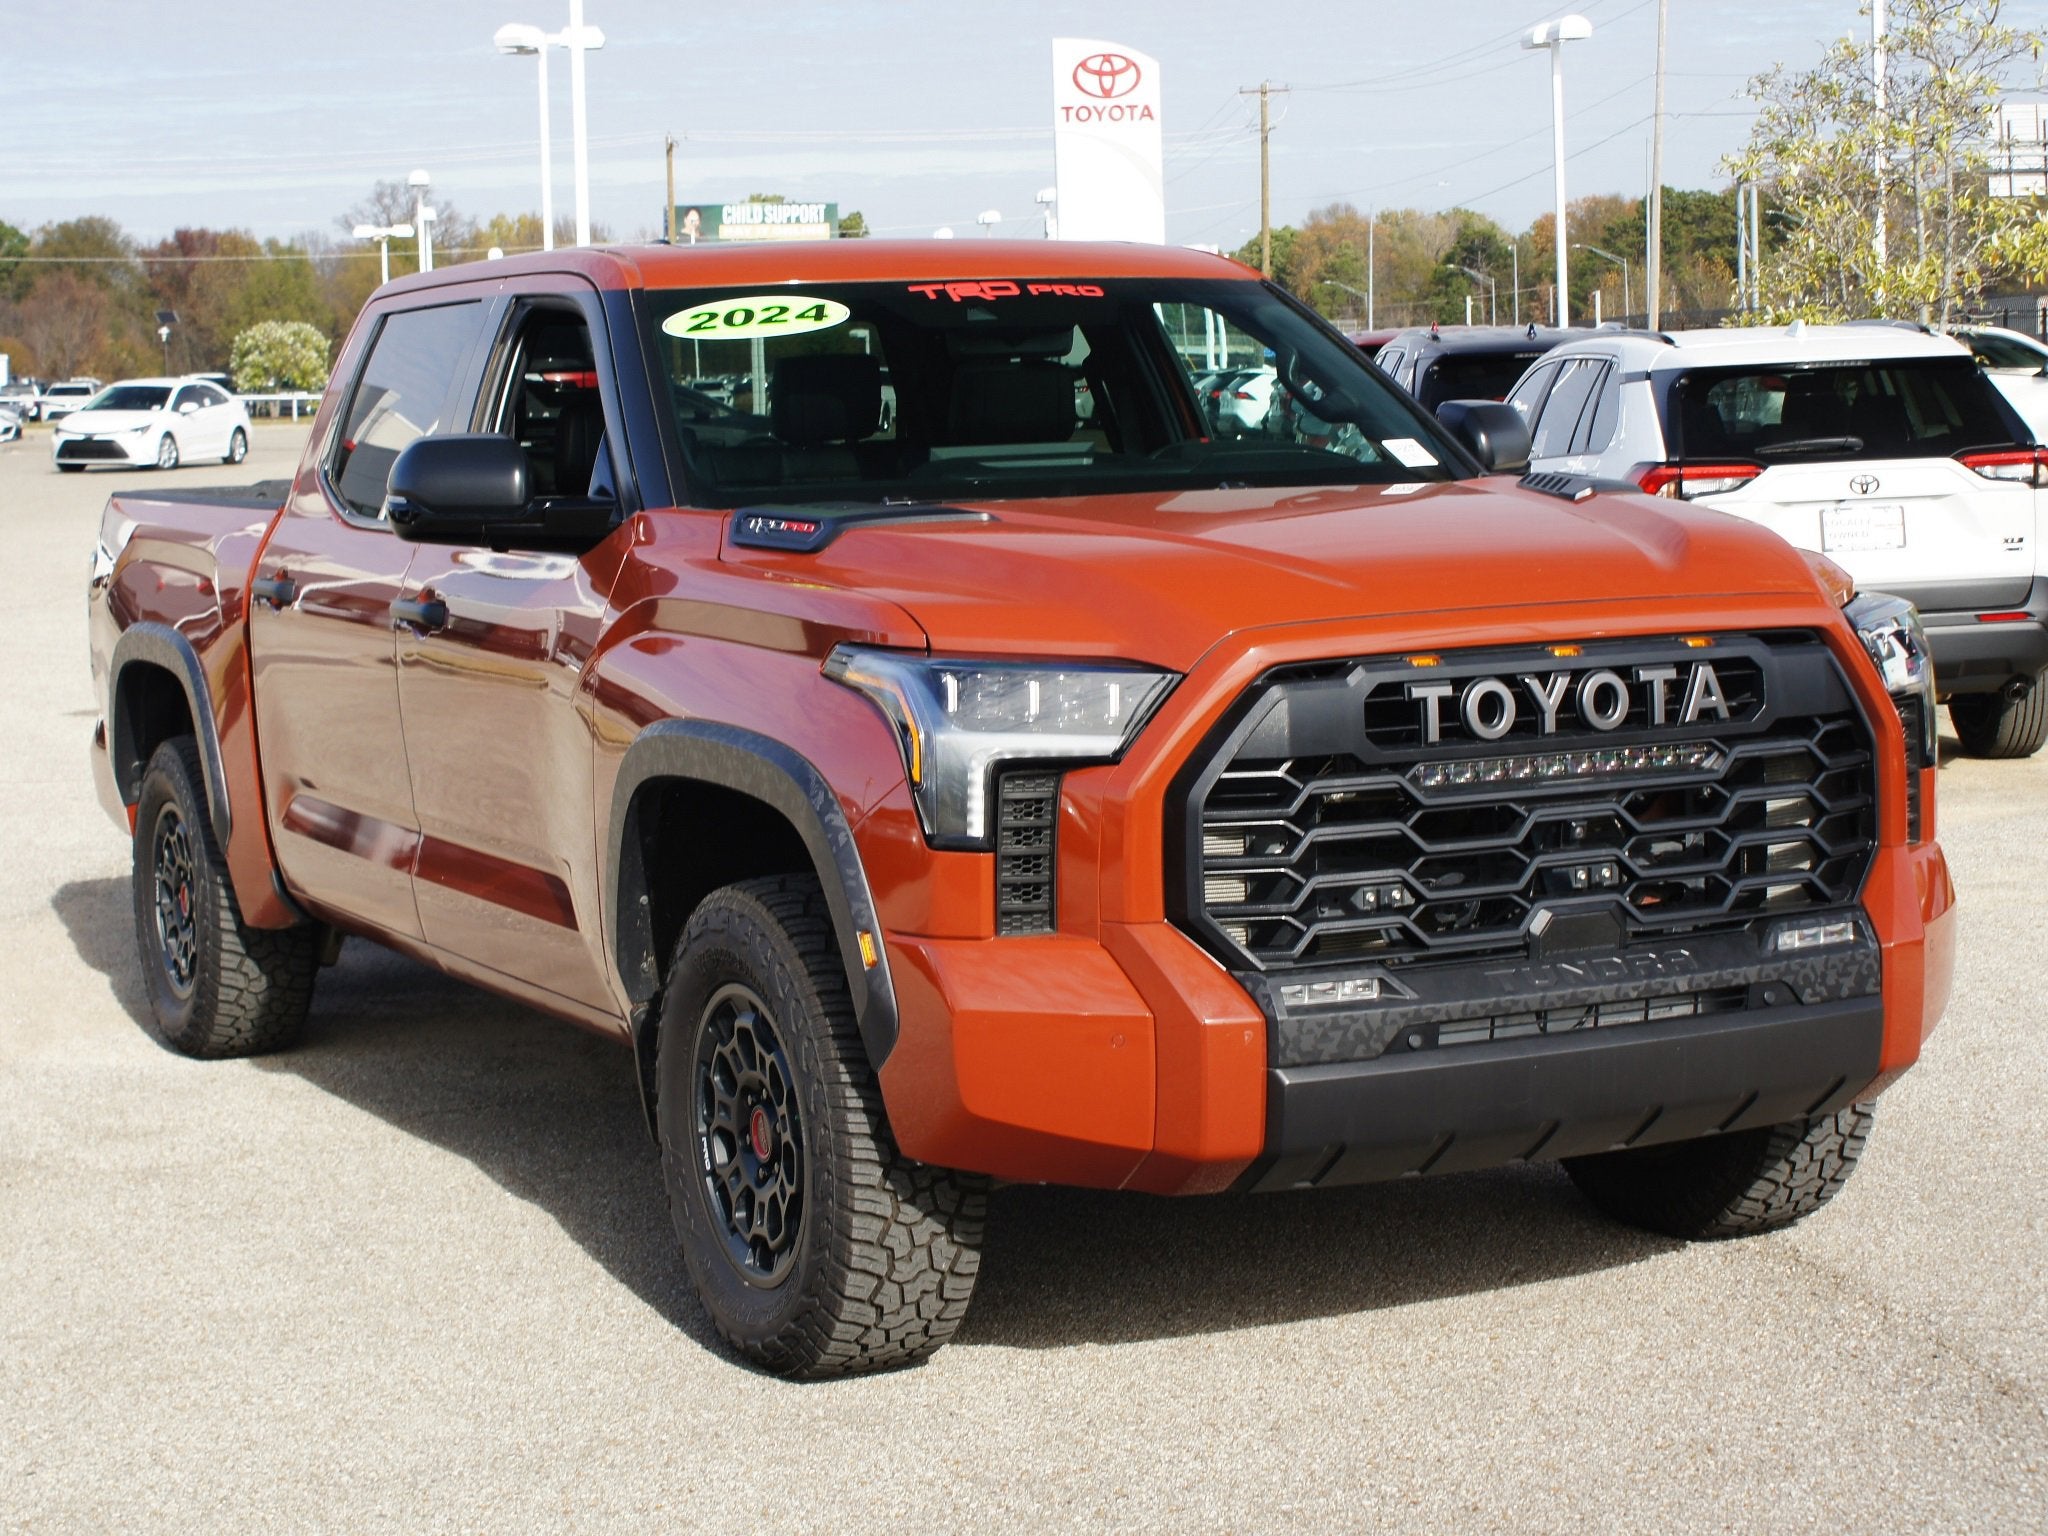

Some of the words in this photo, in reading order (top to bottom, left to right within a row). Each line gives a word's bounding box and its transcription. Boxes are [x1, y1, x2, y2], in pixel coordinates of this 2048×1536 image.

[1061, 105, 1154, 122] TOYOTA
[722, 204, 764, 224] CHILD
[764, 203, 827, 224] SUPPORT
[908, 281, 1020, 302] TRD
[1027, 284, 1104, 297] PRO
[686, 304, 828, 333] 2024
[1405, 661, 1730, 746] TOYOTA
[701, 1136, 711, 1171] PRO
